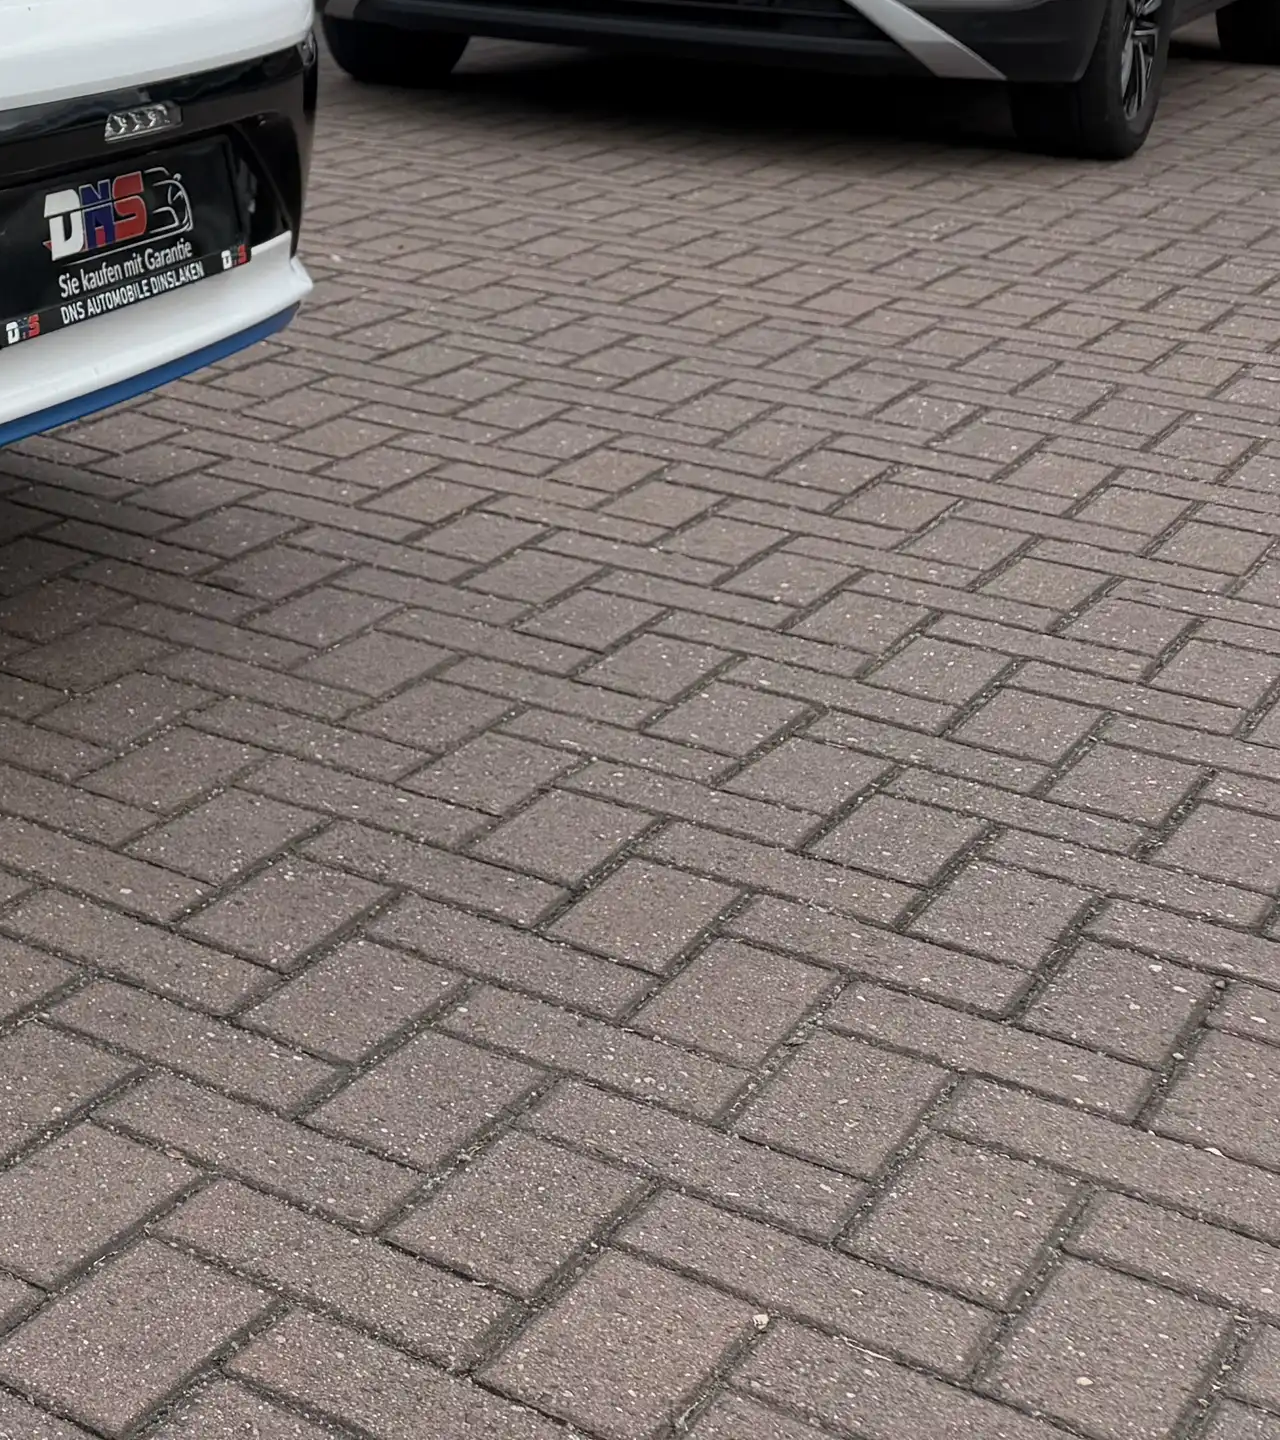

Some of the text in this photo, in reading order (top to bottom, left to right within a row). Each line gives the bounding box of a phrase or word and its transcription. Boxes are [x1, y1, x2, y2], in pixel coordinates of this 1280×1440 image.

[43, 171, 148, 261] DNS
[59, 238, 193, 298] Sie kaufen mit Garantie
[60, 261, 205, 324] DNS AUTOMOBILE DINSLAKEN
